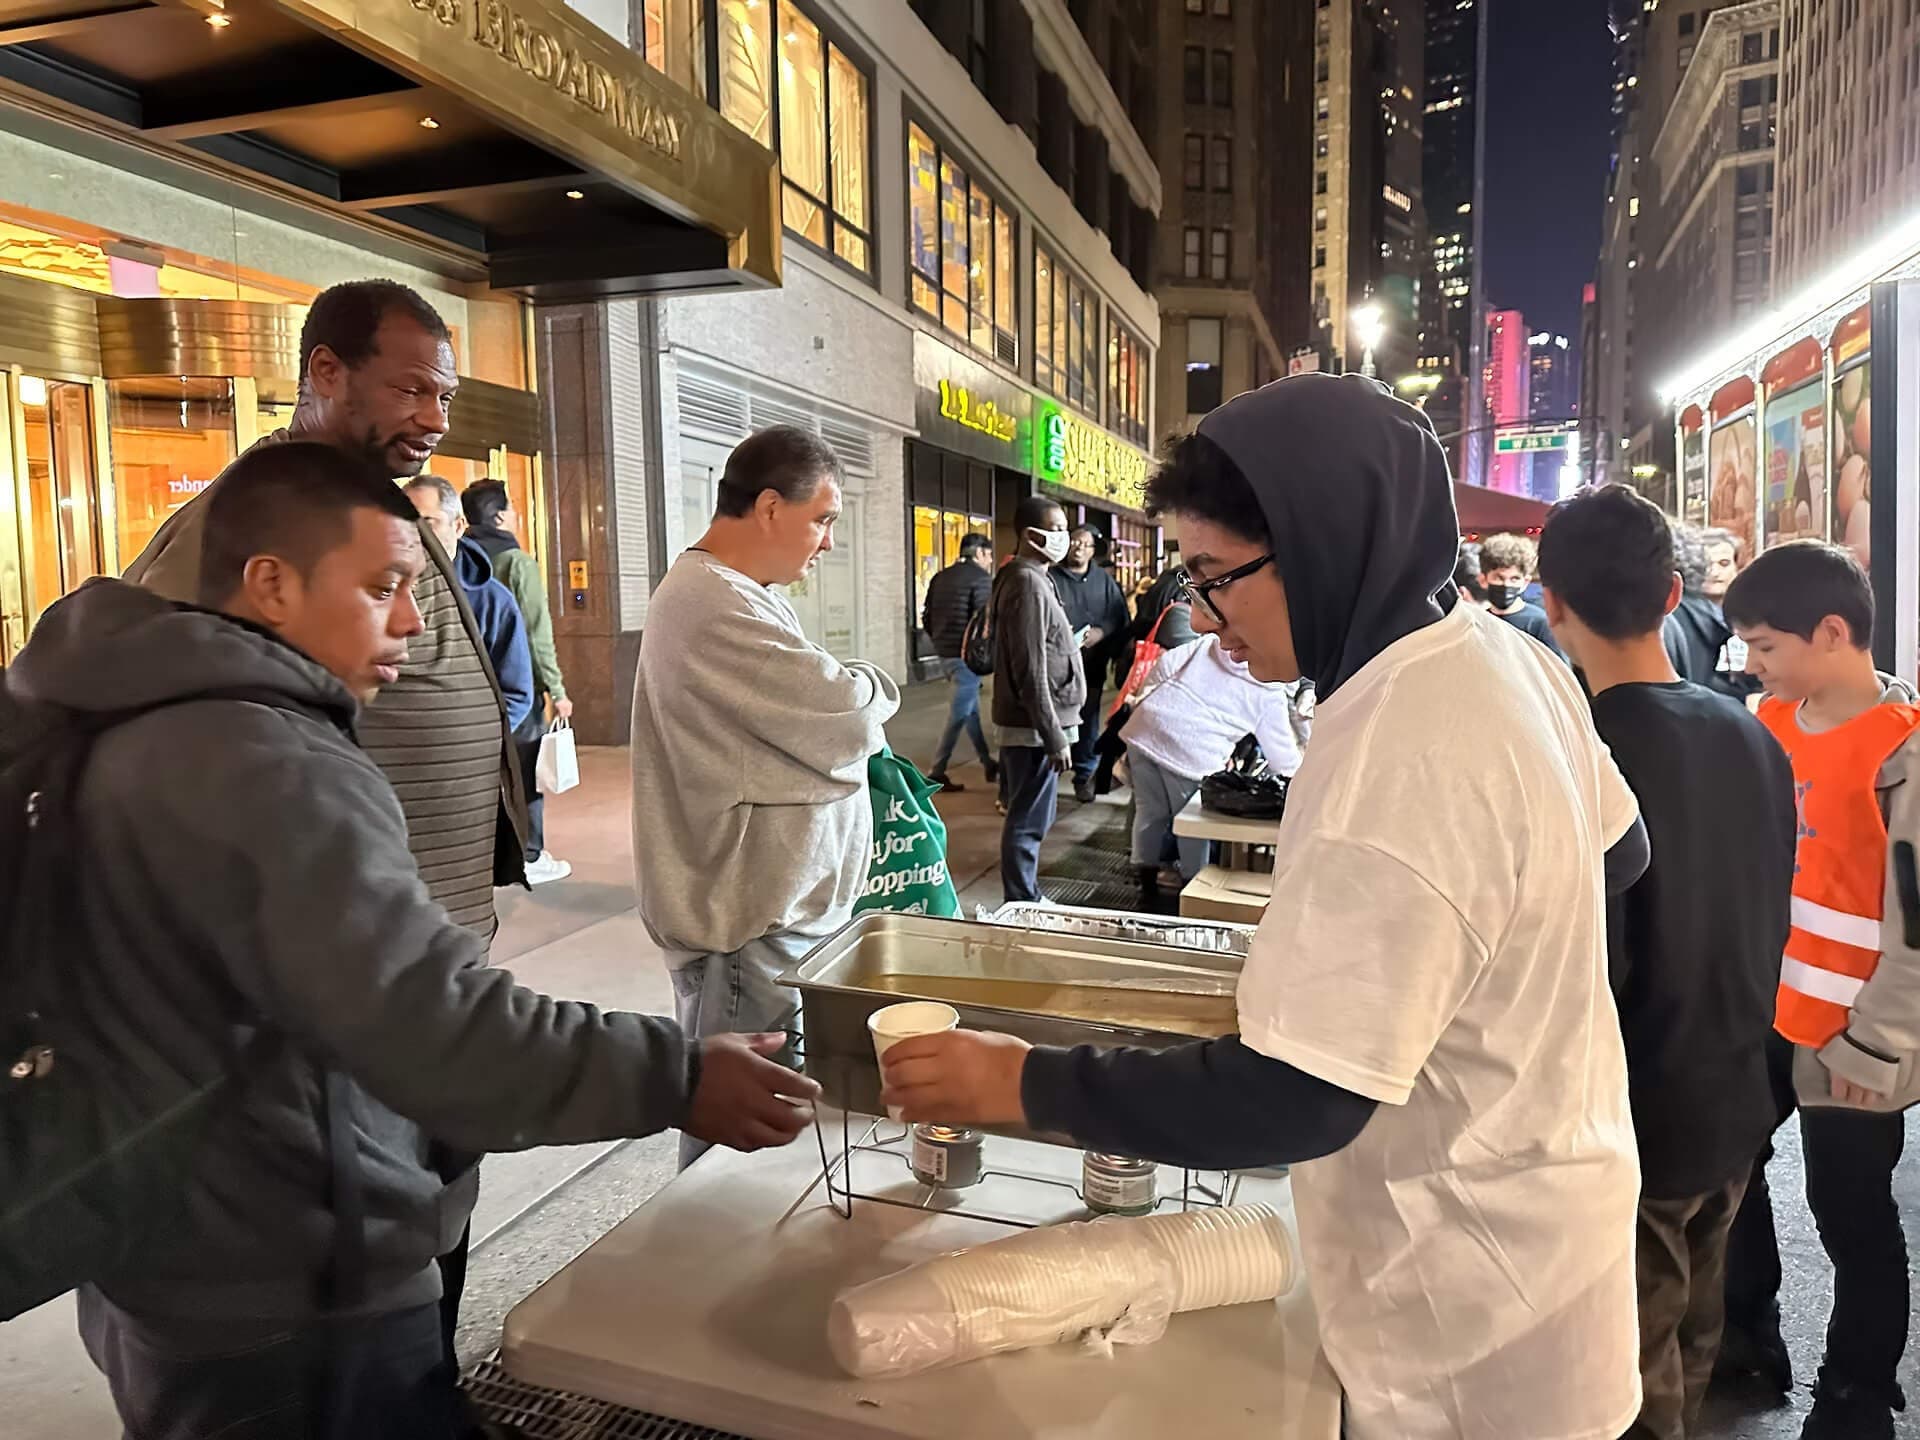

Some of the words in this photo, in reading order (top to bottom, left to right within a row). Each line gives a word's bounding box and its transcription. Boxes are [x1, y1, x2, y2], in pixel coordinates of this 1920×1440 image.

[475, 0, 682, 163] BROADWAY
[1512, 438, 1523, 449] W
[877, 831, 928, 865] for
